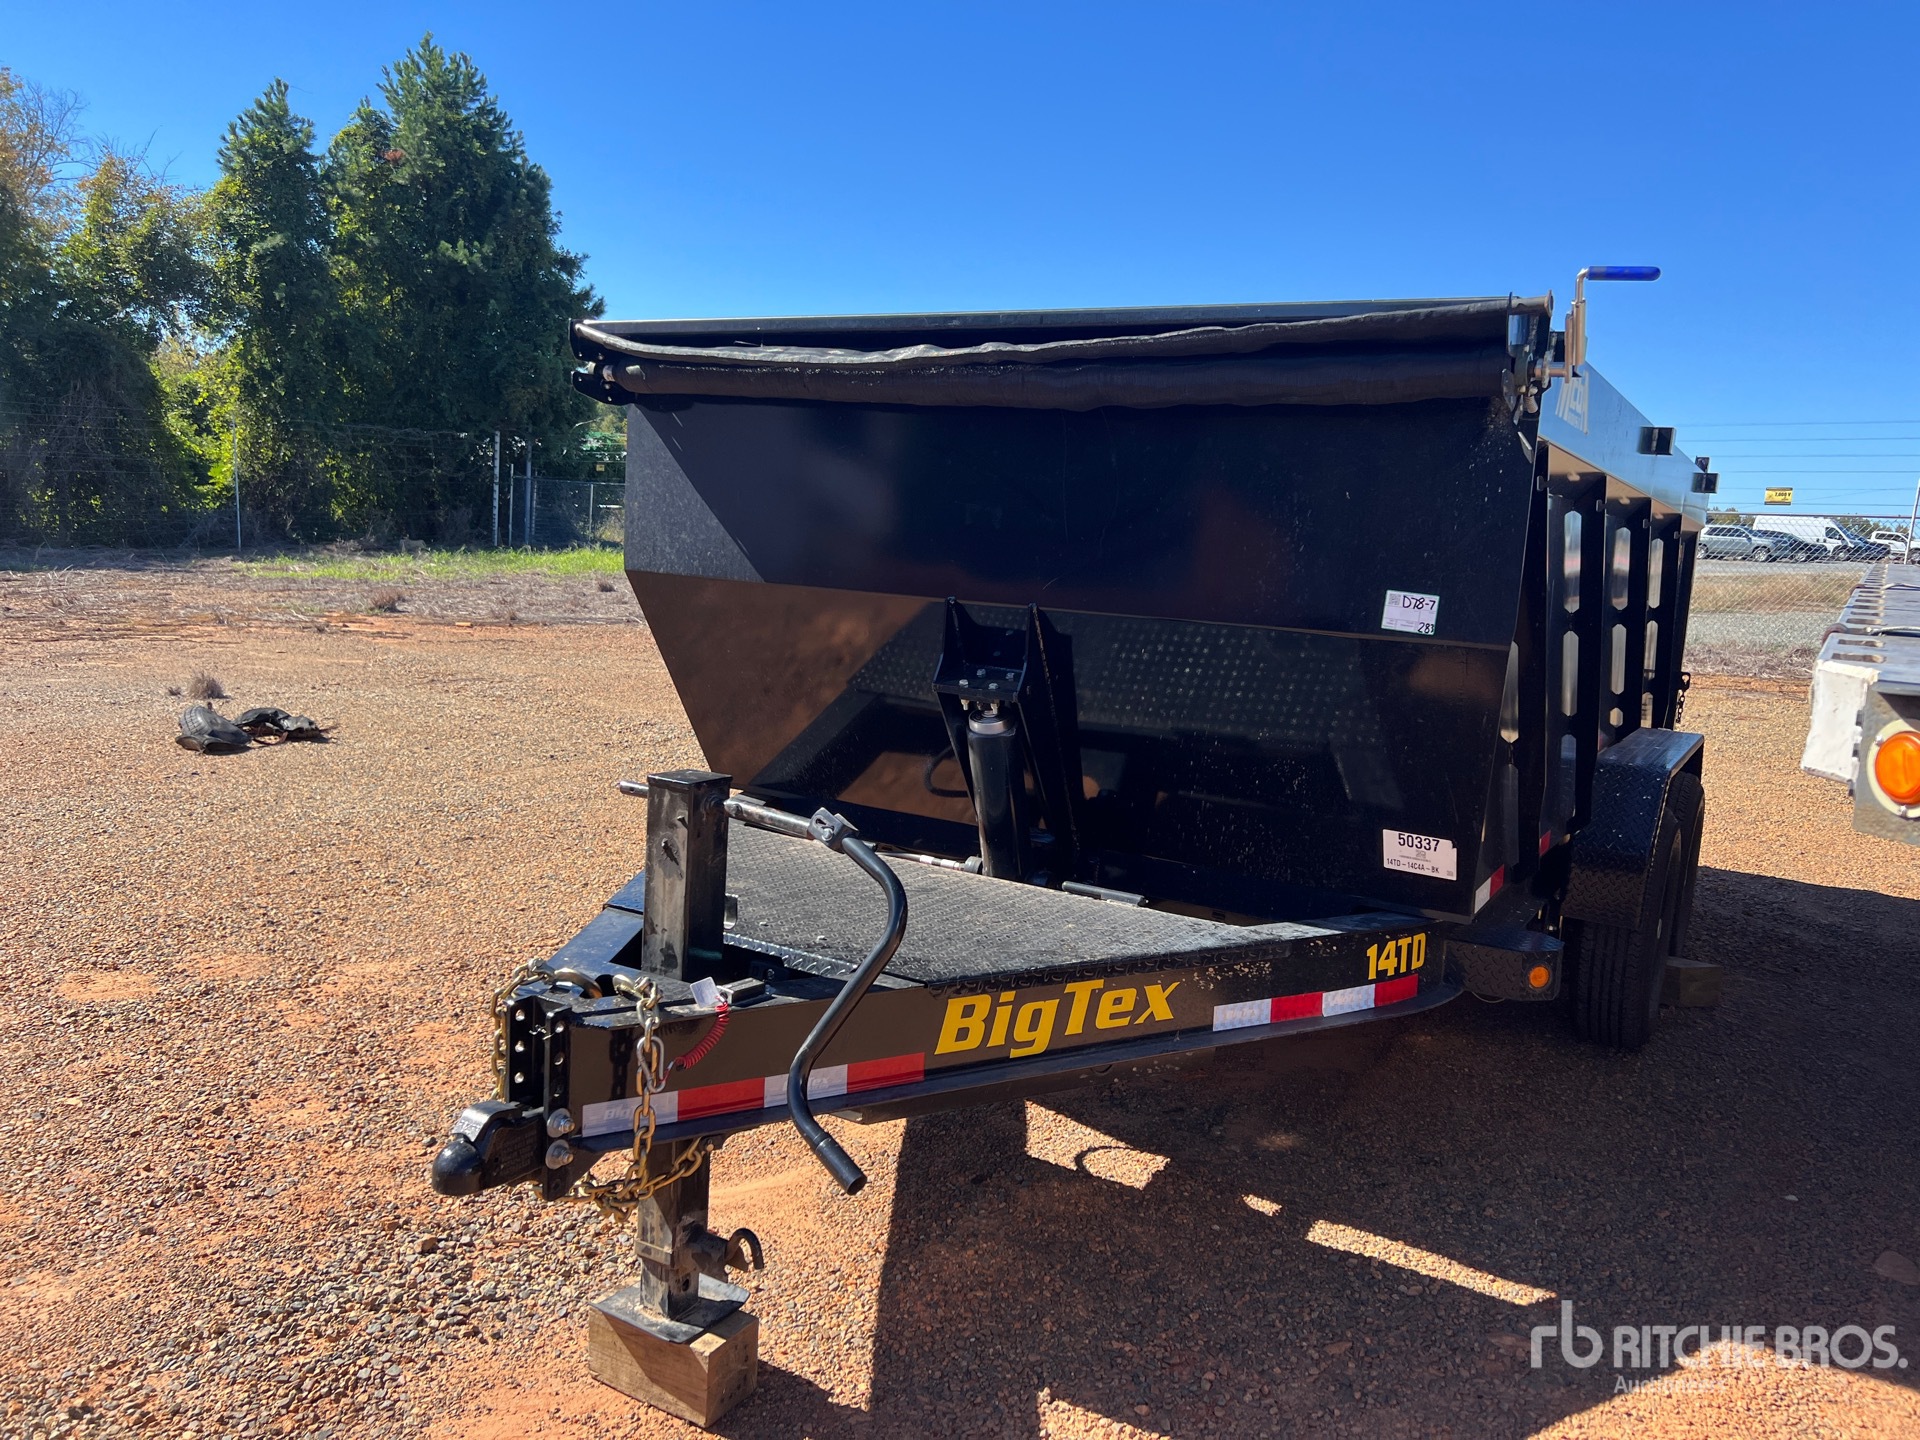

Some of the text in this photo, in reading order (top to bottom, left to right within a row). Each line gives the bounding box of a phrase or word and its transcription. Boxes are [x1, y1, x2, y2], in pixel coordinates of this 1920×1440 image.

[1398, 833, 1440, 852] 50337
[1366, 932, 1426, 980] 14TD
[934, 979, 1180, 1058] BigTex
